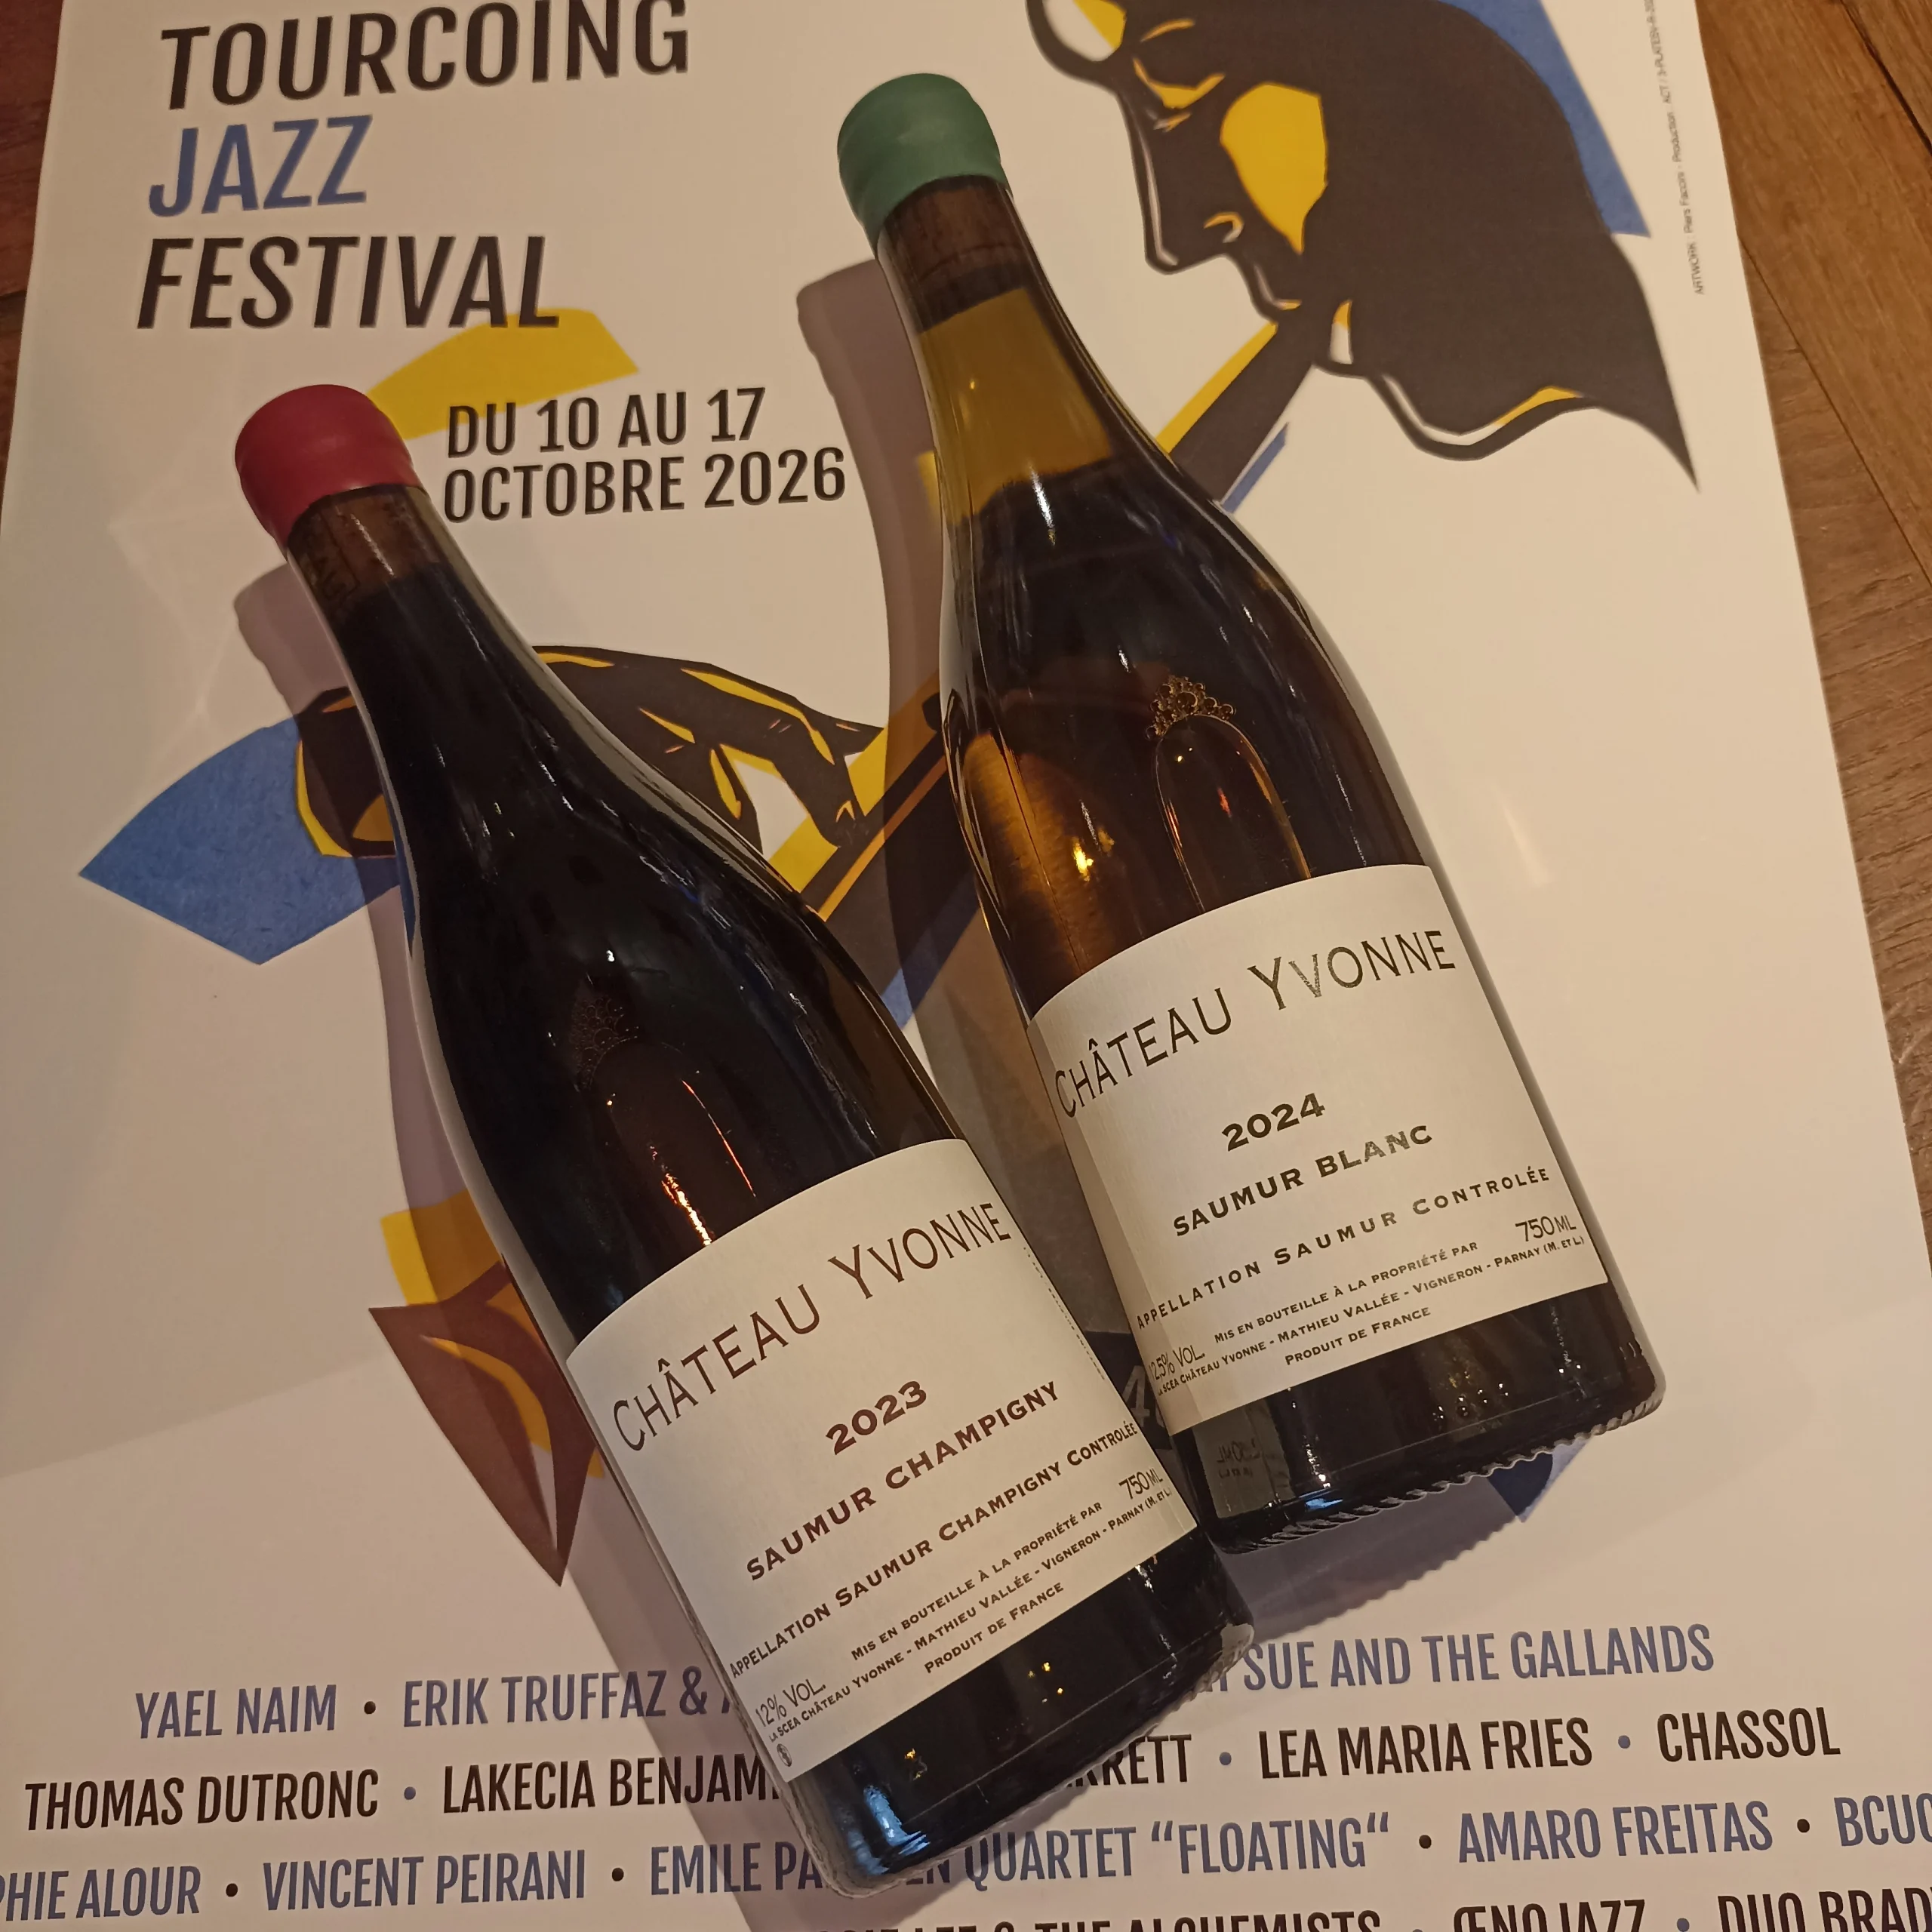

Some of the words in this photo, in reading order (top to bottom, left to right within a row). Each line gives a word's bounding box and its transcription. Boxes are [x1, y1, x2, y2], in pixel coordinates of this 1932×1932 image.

[162, 0, 689, 110] TOURCOING
[149, 115, 373, 217] JAZZ
[137, 235, 560, 329] FESTIVAL
[448, 402, 516, 457] DU
[536, 398, 600, 453] 10
[617, 391, 687, 448] AU
[707, 386, 766, 443] 17
[442, 455, 685, 522] OCTOBRE
[703, 447, 845, 507] 2026
[1054, 988, 1231, 1118] CHÂTEAU
[1247, 931, 1456, 1010] YVONNE
[1222, 1093, 1325, 1152] 2024
[1174, 1168, 1304, 1236] SAUMUR
[1315, 1125, 1432, 1177] BLANC
[1137, 1261, 1260, 1329] APPELLATION
[1274, 1212, 1397, 1265] SAUMUR
[1413, 1166, 1549, 1214] CONTROLÉE
[1214, 1330, 1235, 1343] MIS
[1238, 1322, 1254, 1334] EN
[1257, 1293, 1329, 1326] BOUTEILLE
[1334, 1286, 1343, 1297] À
[1348, 1280, 1367, 1292] LA
[1371, 1249, 1447, 1283] PROPRIÉTÉ
[1452, 1242, 1478, 1257] PAR
[614, 1284, 820, 1451] CHÂTEAU
[828, 1203, 1011, 1299] YVONNE
[1163, 1378, 1180, 1392] SCEA
[1180, 1361, 1220, 1383] CHÂTEAU
[1222, 1342, 1266, 1364] YVONNE
[1278, 1314, 1339, 1343] MATHIEU
[1343, 1293, 1399, 1317] VALLÉE
[1413, 1265, 1482, 1293] VIGNERON
[1494, 1247, 1540, 1267] PARNAY
[1172, 1345, 1205, 1367] VOL.
[1285, 1337, 1342, 1365] PRODUIT
[1348, 1329, 1367, 1343] DE
[1371, 1307, 1430, 1334] FRANCE
[826, 1381, 926, 1455] 2023
[747, 1487, 876, 1580] SAUMUR
[886, 1381, 1057, 1489] CHAMPIGNY
[730, 1603, 831, 1678] APPELLATION
[835, 1540, 933, 1607] SAUMUR
[939, 1461, 1060, 1540] CHAMPIGNY
[1067, 1421, 1137, 1466] CONTROLÉE
[851, 1641, 875, 1660] MIS
[878, 1627, 898, 1644] EN
[901, 1579, 975, 1629] BOUTEILLE
[978, 1570, 989, 1582] À
[992, 1558, 1011, 1573] LA
[1014, 1514, 1078, 1560] PROPRIÉTÉ
[1081, 1503, 1102, 1519] PAR
[777, 1717, 801, 1736] SCEA
[801, 1686, 850, 1721] CHÂTEAU
[852, 1653, 904, 1687] YVONNE
[914, 1607, 976, 1650] MATHIEU
[979, 1573, 1032, 1608] VALLÉE
[1041, 1531, 1100, 1570] VIGNERON
[1108, 1504, 1144, 1530] PARNAY
[924, 1632, 982, 1673] PRODUIT
[987, 1618, 1007, 1635] DE
[1009, 1583, 1063, 1620] FRANCE
[1244, 1641, 1318, 1690] SUE
[1331, 1638, 1411, 1687] AND
[1421, 1633, 1500, 1682] THE
[1511, 1623, 1714, 1678] GALLANDS
[136, 1690, 222, 1739] YAEL
[237, 1684, 336, 1735] NAIM
[404, 1678, 489, 1727] ERIK
[501, 1670, 666, 1724] TRUFFAZ
[680, 1666, 708, 1715] &
[755, 1694, 786, 1727] 12%
[783, 1679, 826, 1707] VOL.
[1259, 1729, 1327, 1779] LEA
[1338, 1723, 1471, 1776] MARIA
[1481, 1717, 1592, 1770] FRIES
[1657, 1707, 1841, 1762] CHASSOL
[25, 1777, 184, 1831] THOMAS
[198, 1769, 378, 1823] DUTRONC
[444, 1760, 595, 1814] LAKECIA
[609, 1753, 780, 1807] BENJAM
[0, 1870, 69, 1921] HIE
[75, 1866, 201, 1918] ALOUR
[263, 1857, 424, 1910] VINCENT
[436, 1850, 585, 1904] PEIRANI
[651, 1841, 761, 1896] EMILE
[964, 1826, 1136, 1891] QUARTET
[1460, 1808, 1601, 1863] AMARO
[1613, 1801, 1773, 1856] FREITAS
[1717, 1892, 1807, 1932] DUO
[1818, 1886, 1932, 1932] BRAD
